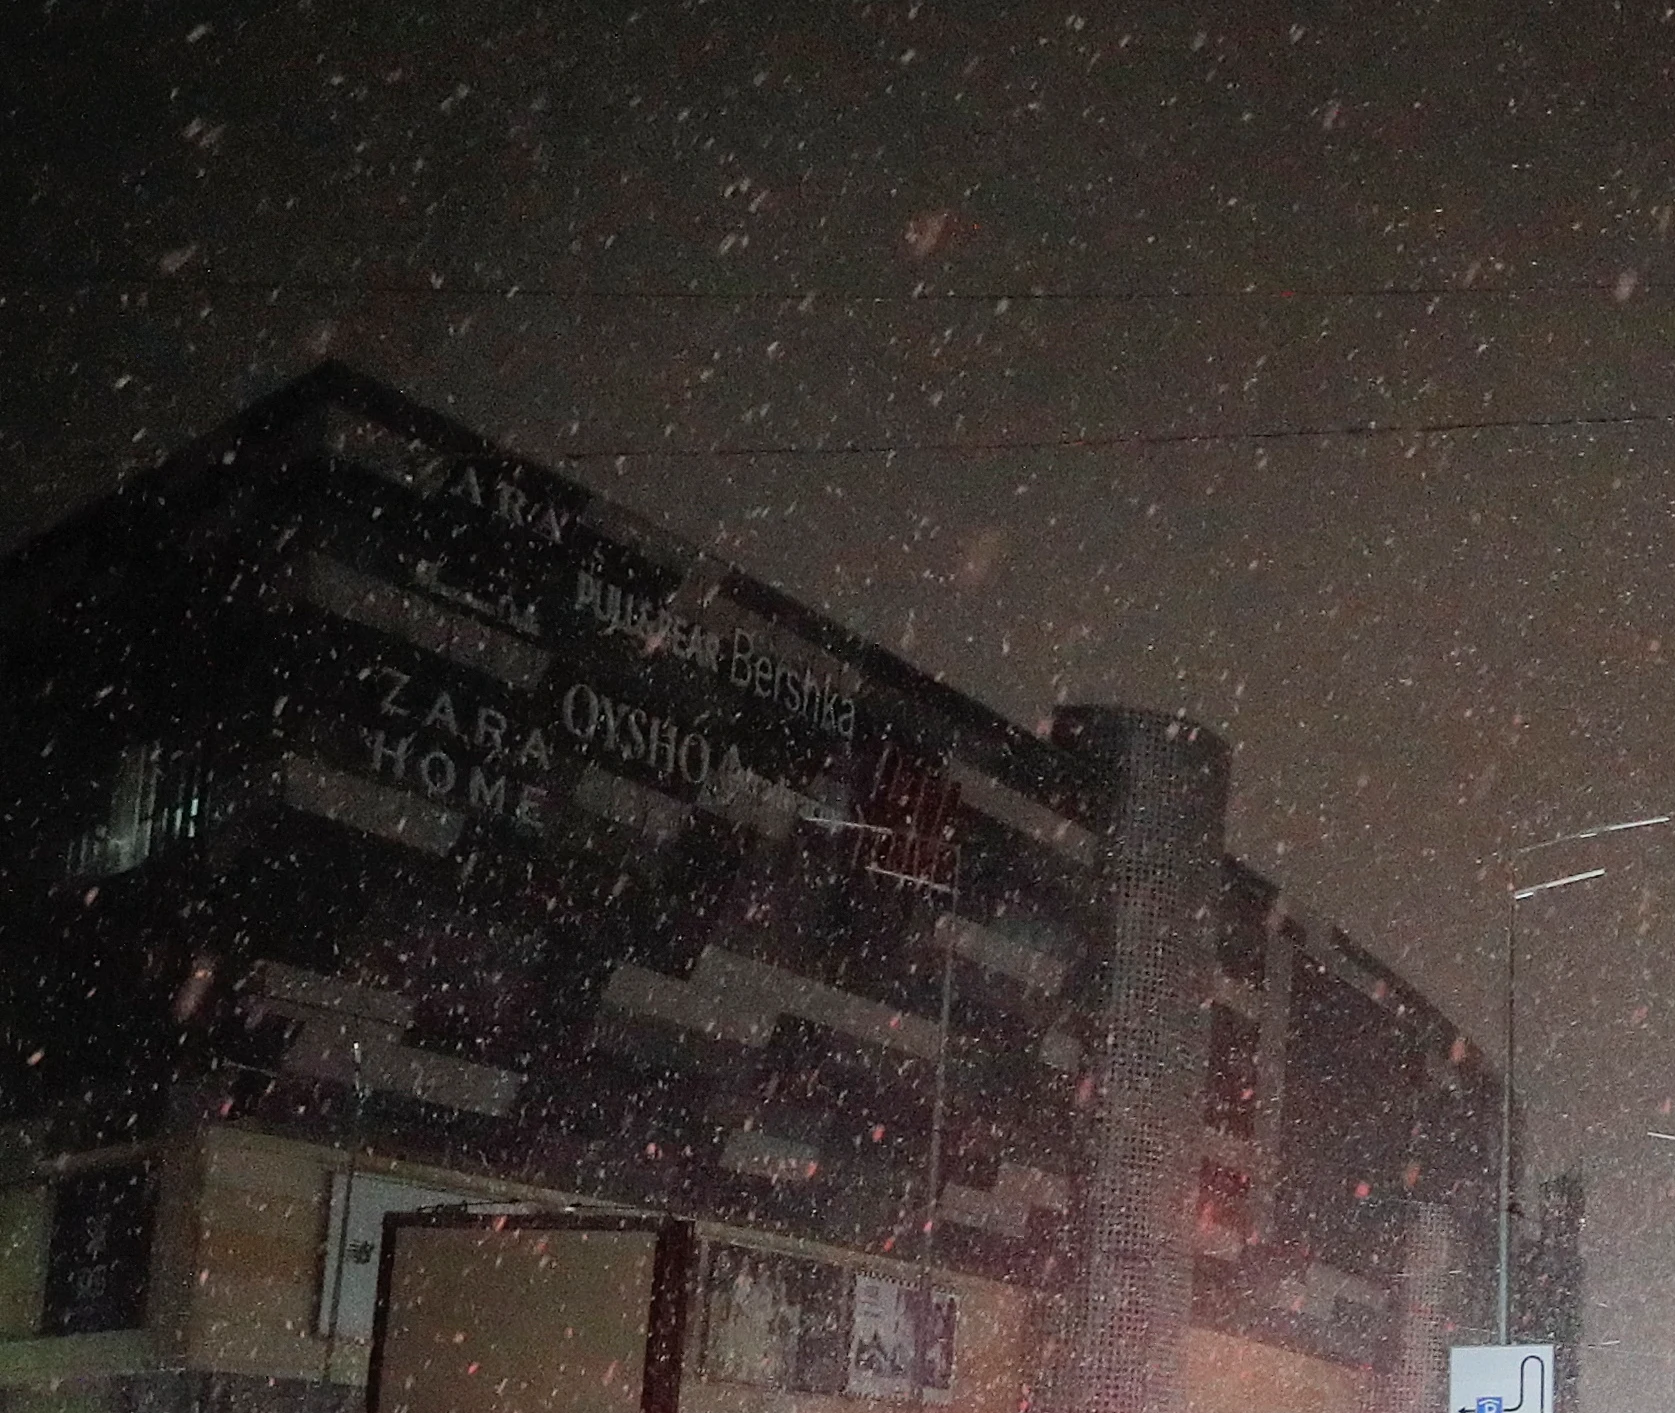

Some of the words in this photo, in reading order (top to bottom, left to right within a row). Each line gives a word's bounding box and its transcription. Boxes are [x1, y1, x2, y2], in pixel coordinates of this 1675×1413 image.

[376, 664, 554, 774] ZARA
[562, 683, 711, 786] OYSHO
[730, 626, 856, 744] Bershka
[366, 728, 547, 831] HOME
